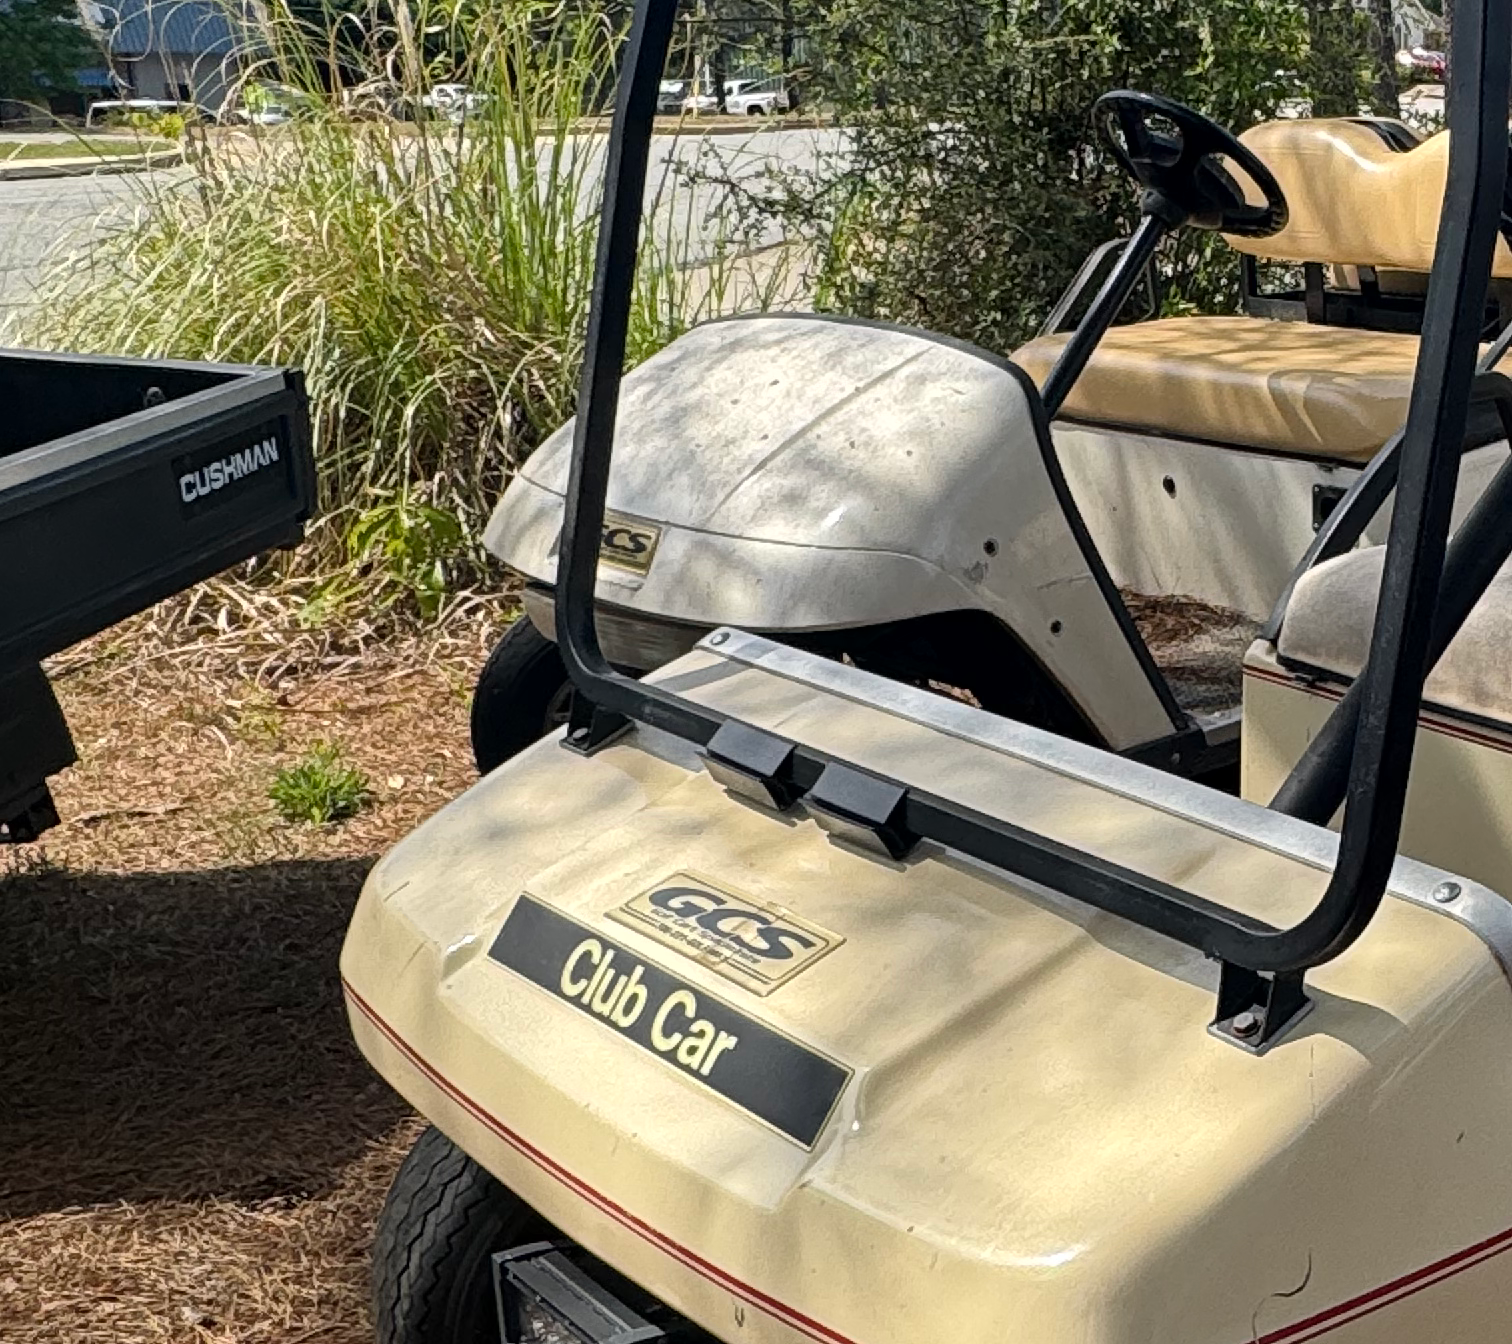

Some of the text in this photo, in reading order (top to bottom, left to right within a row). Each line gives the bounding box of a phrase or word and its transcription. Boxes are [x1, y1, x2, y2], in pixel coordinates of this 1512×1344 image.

[179, 436, 280, 502] CUSHMAN
[600, 524, 652, 553] CS
[648, 886, 818, 960] GCS
[559, 937, 738, 1077] Club Car
